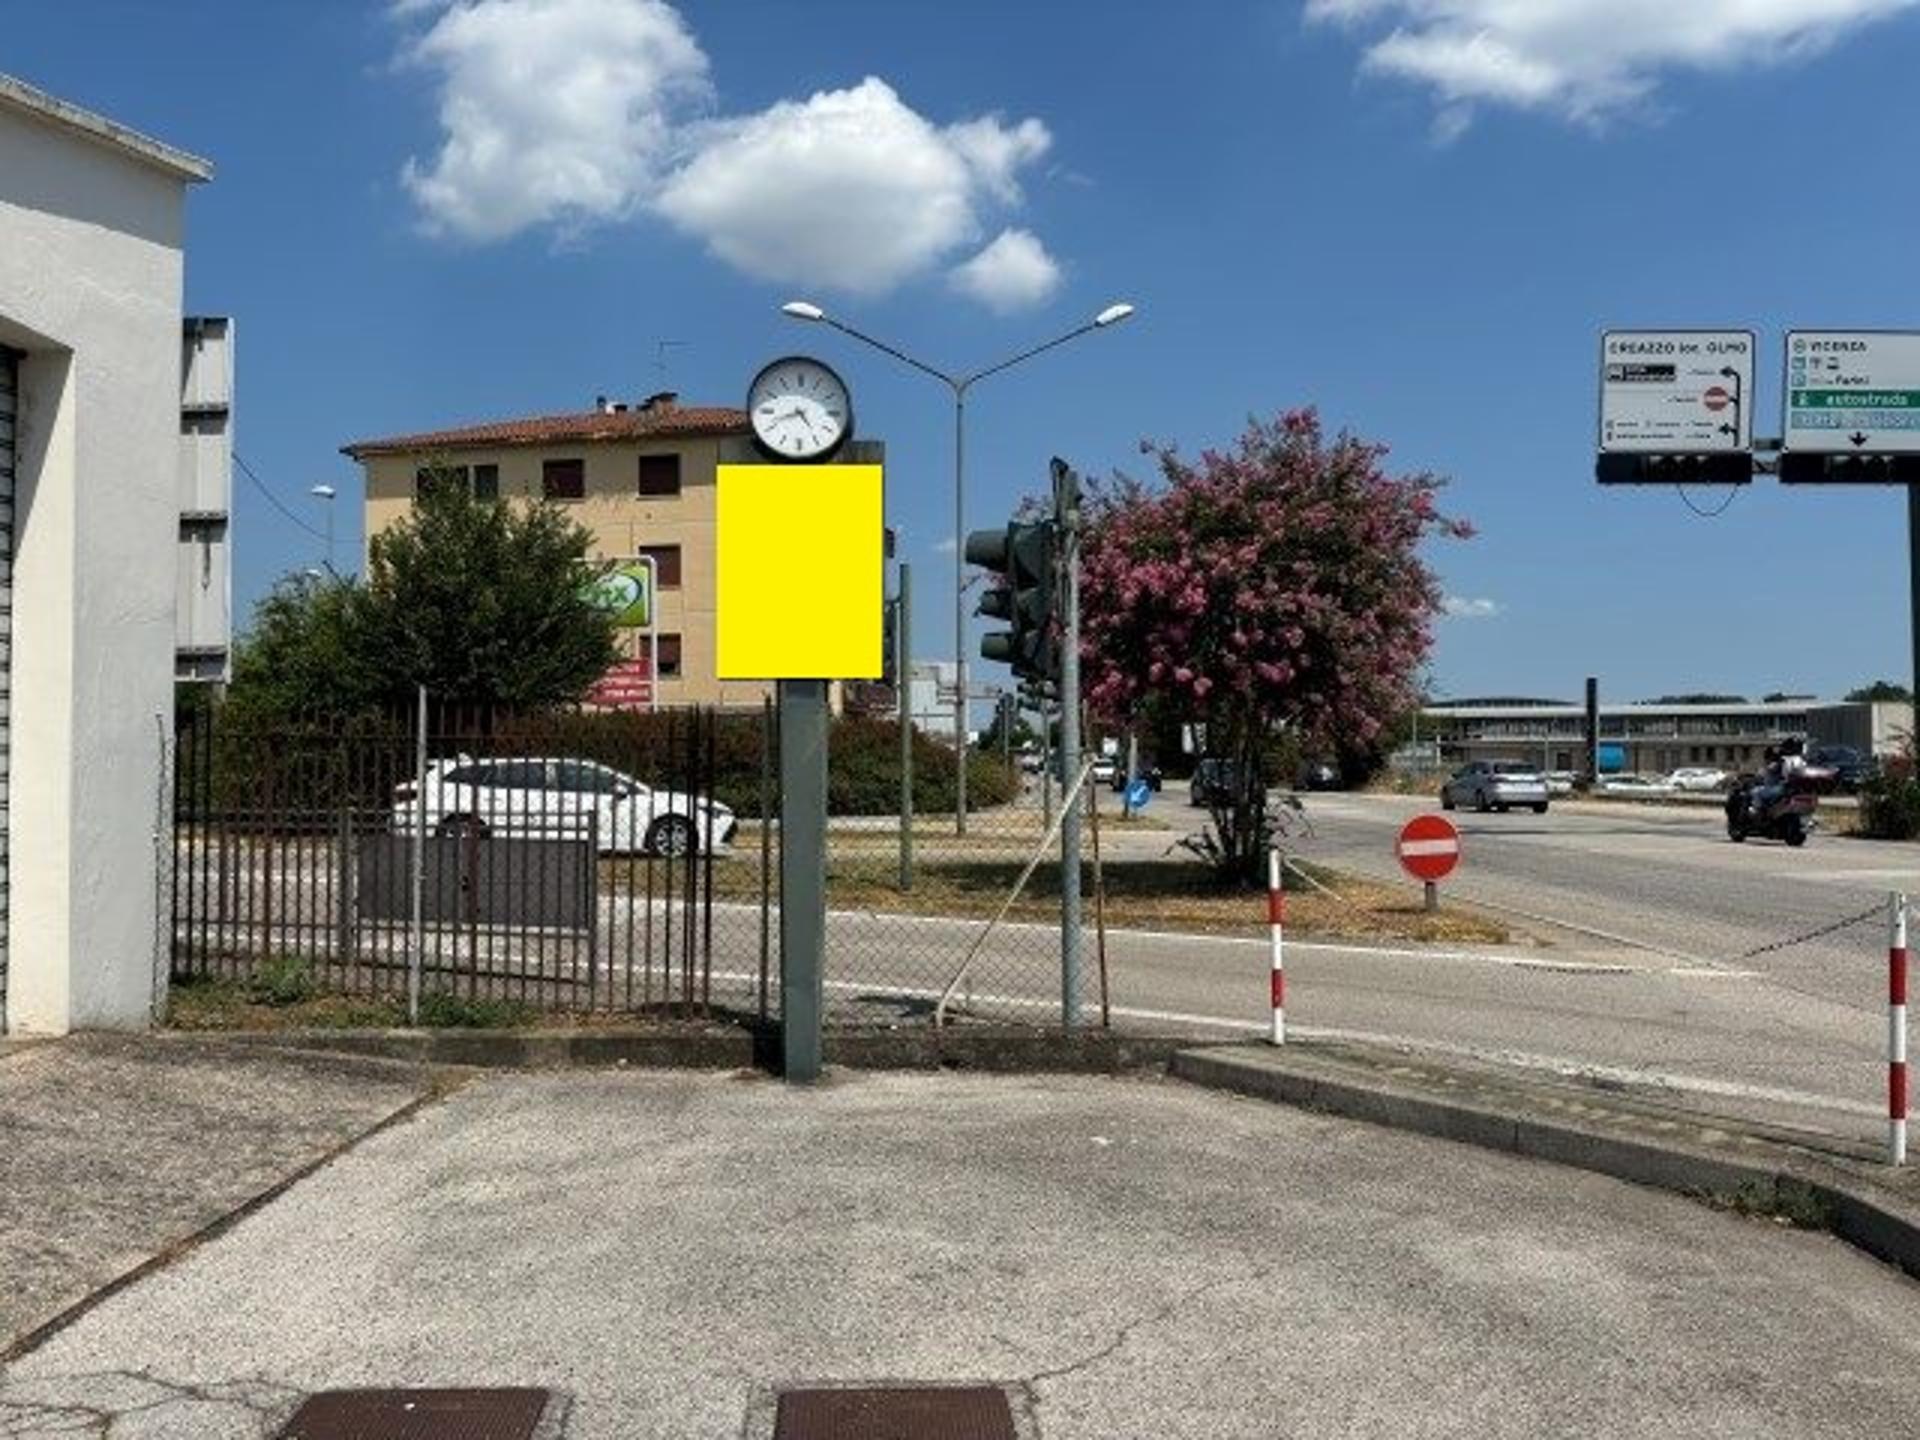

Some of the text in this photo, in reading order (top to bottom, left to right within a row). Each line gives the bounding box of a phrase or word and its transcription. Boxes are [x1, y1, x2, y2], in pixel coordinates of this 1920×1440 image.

[1609, 341, 1675, 355] CREAZZO
[1706, 341, 1747, 355] OLMO
[1811, 340, 1868, 352] VICENZA
[1826, 392, 1909, 406] autostrada
